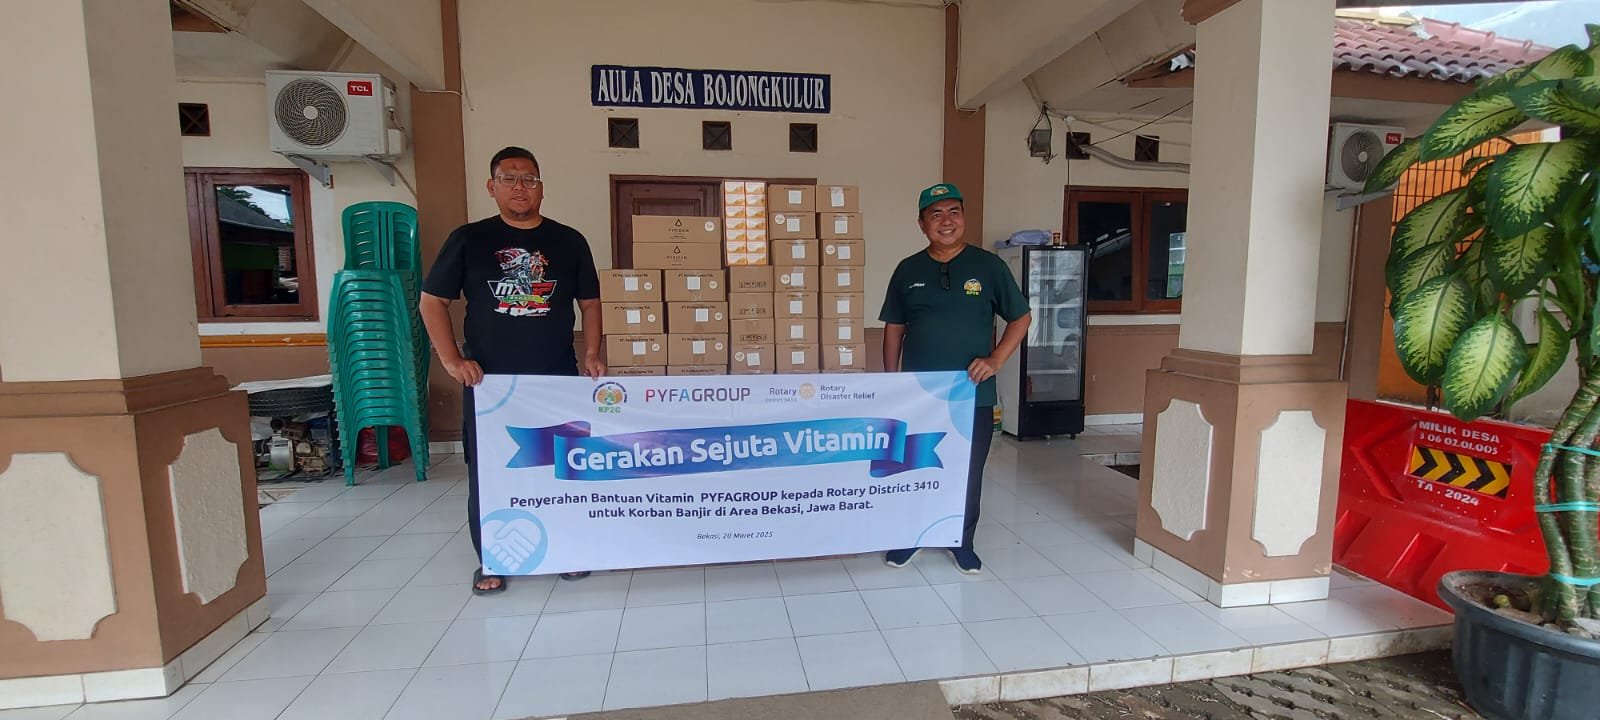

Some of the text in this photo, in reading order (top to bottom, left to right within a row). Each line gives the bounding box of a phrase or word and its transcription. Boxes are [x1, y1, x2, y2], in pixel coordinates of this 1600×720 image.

[597, 69, 825, 109] AULA DESA BOJONGKULUR
[645, 387, 751, 402] PYFAGROUP
[769, 387, 797, 396] Rotary
[820, 384, 846, 393] Rotary
[853, 391, 875, 400] Relief
[1418, 421, 1500, 443] MILIK DESA
[567, 425, 890, 471] Gerakan Sejuta Vitamin
[510, 480, 940, 508] Penyerahan Bantuan Vitamin PYFAGROUP kepada Rotary District 3410
[1417, 480, 1433, 492] TA
[1444, 489, 1479, 506] 2024
[588, 500, 874, 519] untuk Korban Banjir di Area Bekasi, Jawa Barat.
[734, 531, 754, 539] Maret
